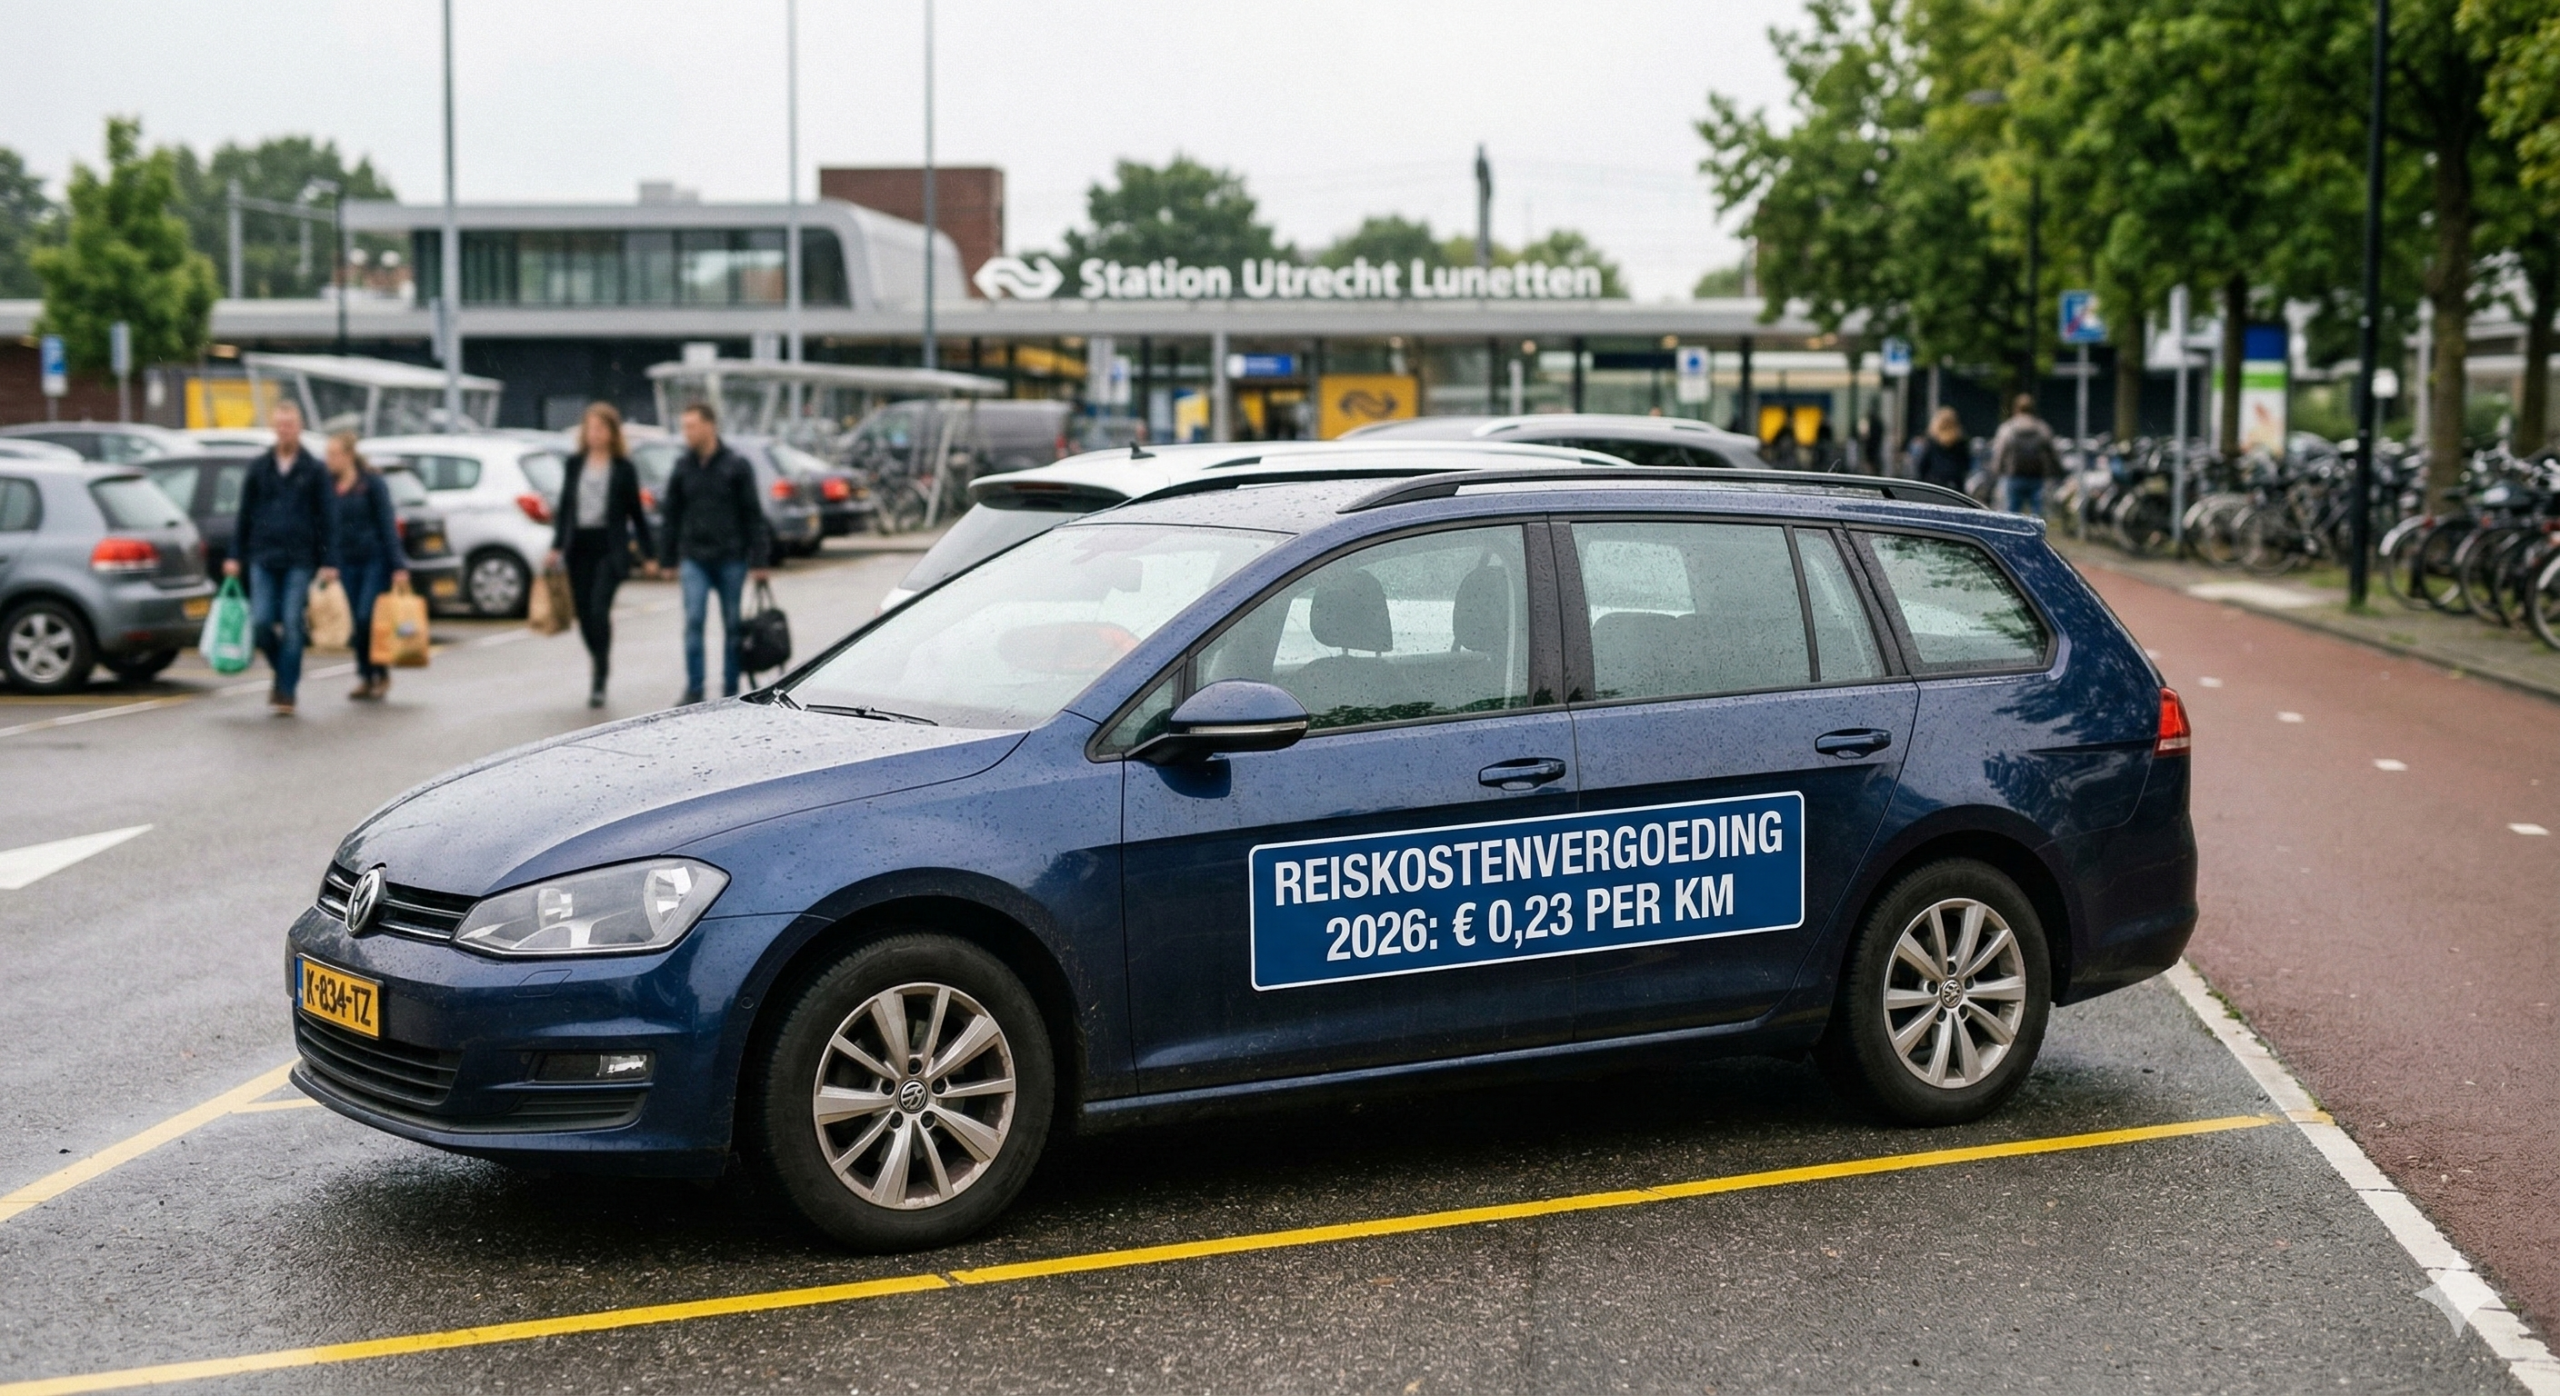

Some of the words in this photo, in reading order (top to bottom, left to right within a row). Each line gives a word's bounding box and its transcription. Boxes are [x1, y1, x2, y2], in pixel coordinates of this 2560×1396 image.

[1079, 256, 1232, 298] Station
[1242, 256, 1400, 298] Utrecht
[1410, 257, 1602, 298] Lunetten
[1275, 810, 1783, 906] REISKOSTENVERGOEDING
[1325, 916, 1438, 962] 2026:
[1452, 902, 1477, 947] €
[1488, 894, 1573, 949] 0,23
[1586, 884, 1661, 932] PER
[1675, 873, 1734, 922] KM
[306, 968, 371, 1028] K-834-TZ
